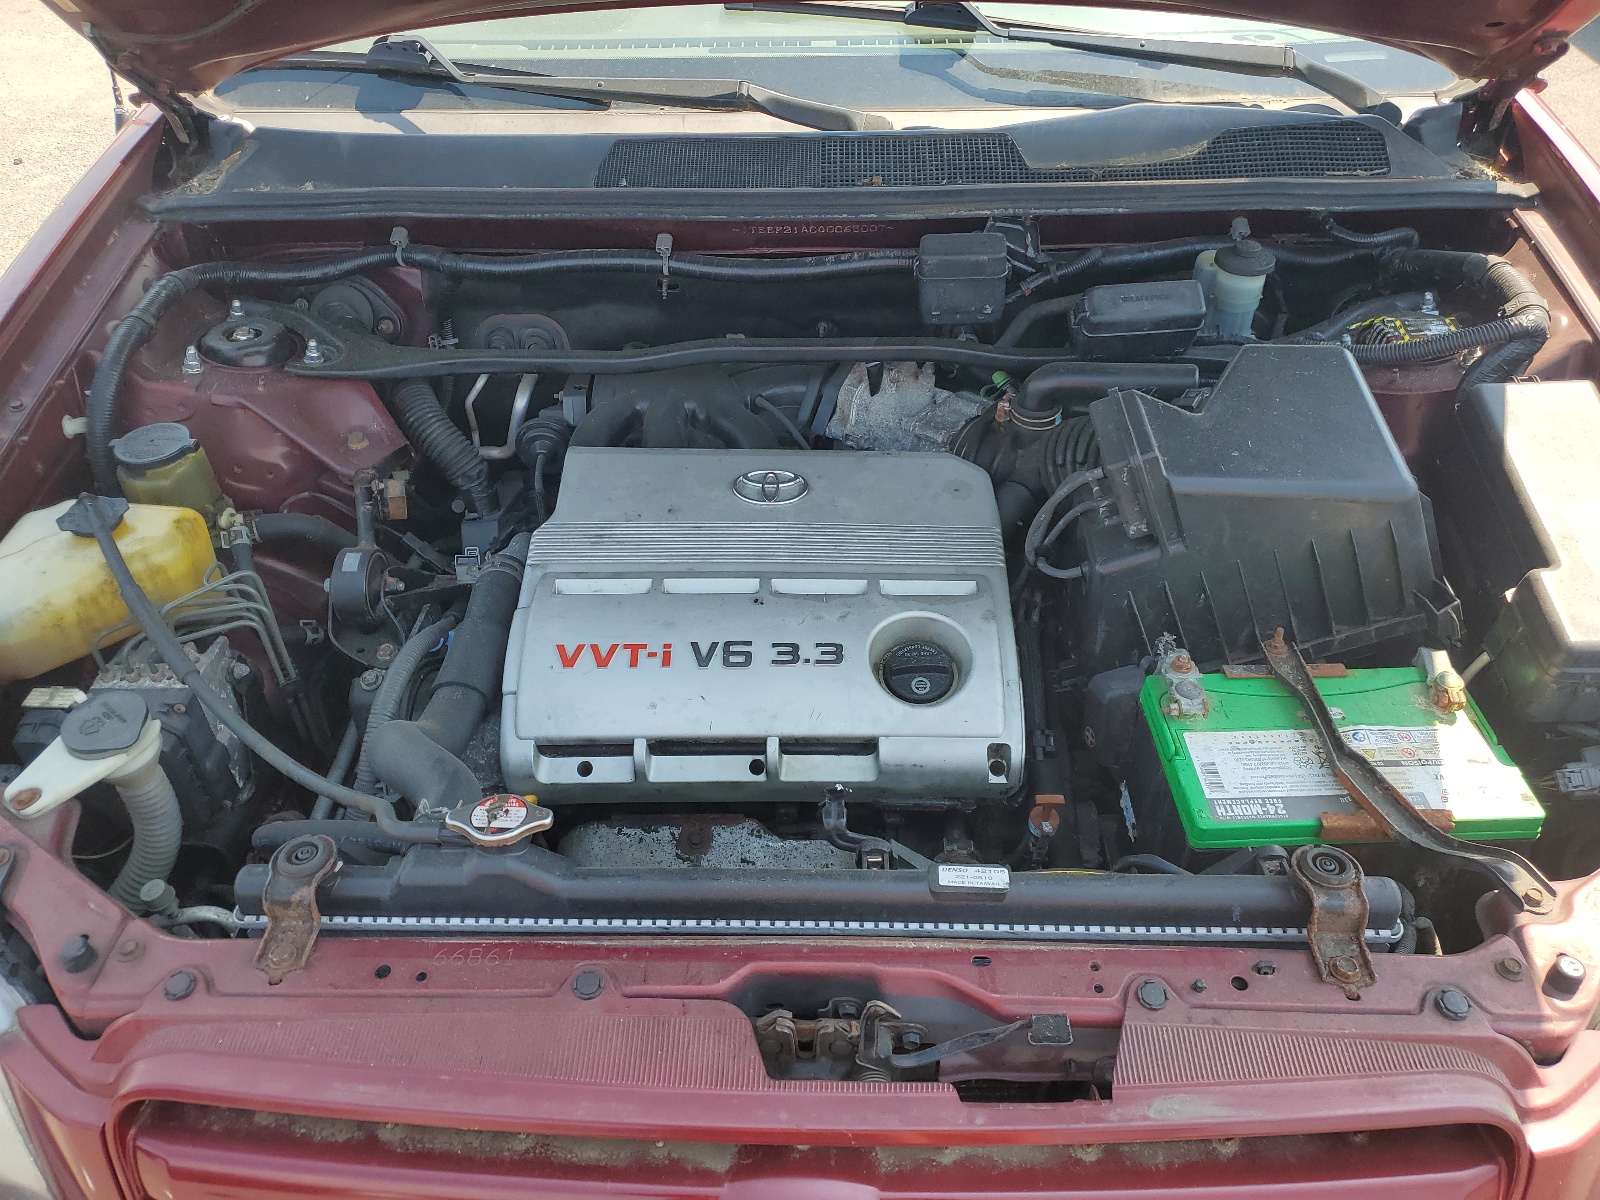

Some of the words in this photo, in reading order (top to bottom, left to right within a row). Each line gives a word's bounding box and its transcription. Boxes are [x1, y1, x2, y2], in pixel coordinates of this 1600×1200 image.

[555, 643, 673, 669] VVT-i
[690, 640, 753, 669] V6
[770, 642, 845, 667] 3.3
[1214, 803, 1287, 816] 24-MONTH
[432, 947, 514, 966] 66861
